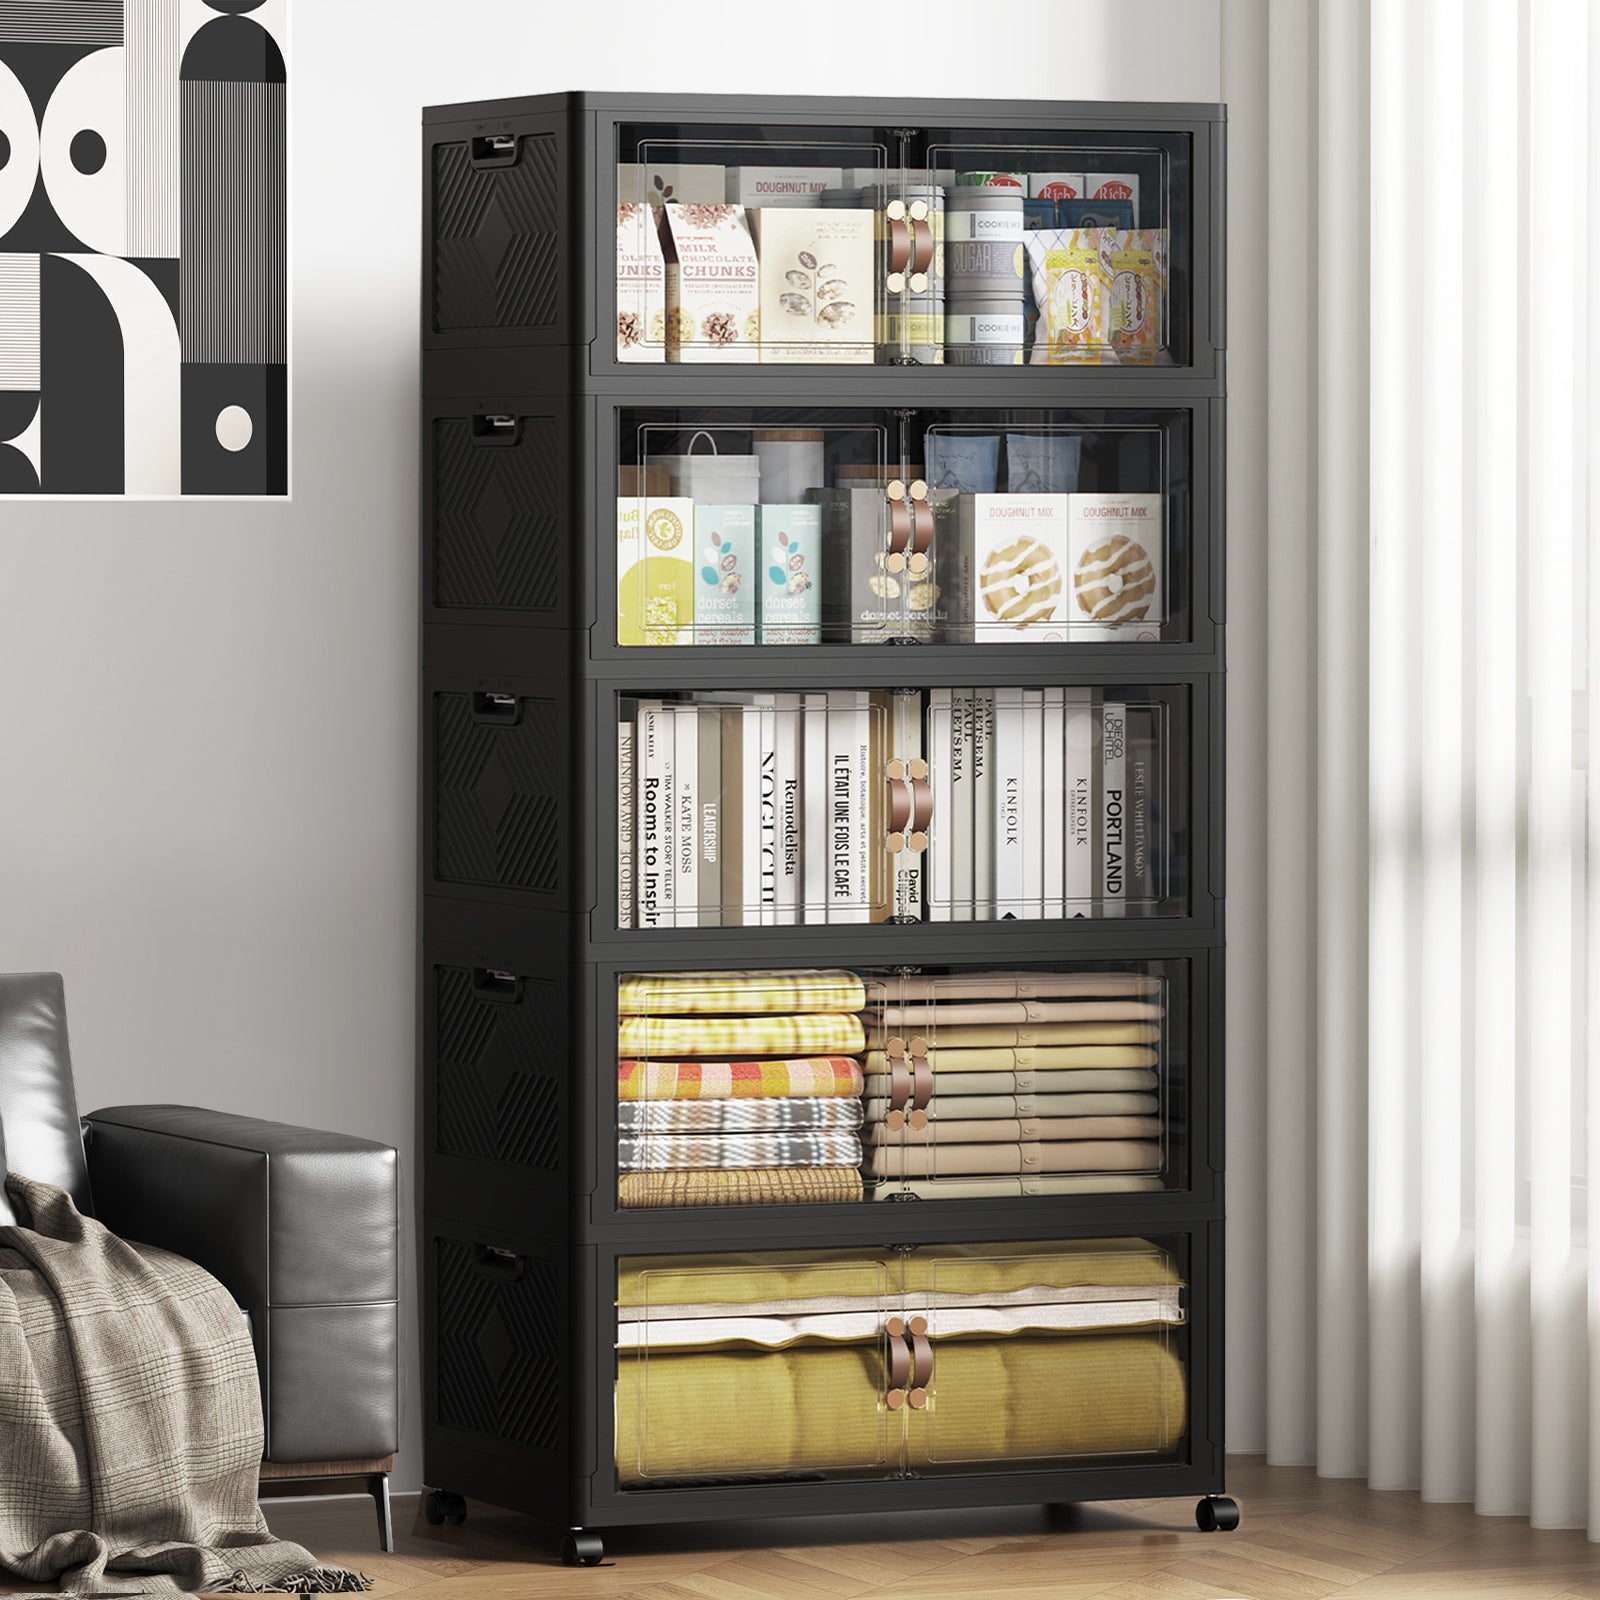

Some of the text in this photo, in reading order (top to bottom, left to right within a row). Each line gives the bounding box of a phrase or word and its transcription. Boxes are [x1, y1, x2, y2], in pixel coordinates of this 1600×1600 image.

[756, 182, 827, 193] DOUGHNUT MIX
[1043, 186, 1071, 199] Rich
[1100, 186, 1127, 199] Rich
[978, 220, 1009, 229] COOKIE
[679, 244, 717, 252] MILK
[953, 243, 992, 272] SUGAR
[618, 264, 662, 276] UNKS
[683, 265, 756, 276] CHUNKS
[978, 324, 1009, 332] COOKIE
[989, 507, 1054, 518] DOUGHNUT MIX
[1083, 507, 1147, 518] DOUGHNUT MIX
[697, 596, 738, 610] dorset
[697, 611, 744, 623] cereals
[764, 596, 806, 610] dorset
[764, 611, 810, 623] cereals
[964, 698, 973, 742] PAUL
[985, 698, 993, 740] PAUL
[953, 697, 962, 783] SIETSEMA
[975, 697, 984, 779] SIETSEMA
[1114, 719, 1123, 759] DIEGO
[859, 744, 867, 779] Histoire,
[1134, 761, 1144, 797] LESLIE
[858, 780, 867, 820] botanique,
[1006, 778, 1017, 845] KINFOLK
[1076, 778, 1087, 846] KINFOLK
[621, 736, 632, 923] SECRETO DE GRAY MOUNTAIN
[664, 774, 672, 900] TIM WALKER STORY TELLER
[681, 795, 692, 874] KATE MOSS
[703, 803, 717, 863] LEADERSHIP
[785, 778, 798, 876] Remodelista
[834, 754, 852, 897] IL ÉTAIT UNE FOIS LE CAFÉ
[1106, 790, 1122, 894] PORTLAND
[641, 778, 661, 928] Rooms to Inspir
[858, 851, 867, 873] petits
[860, 841, 867, 850] et
[909, 869, 919, 903] David
